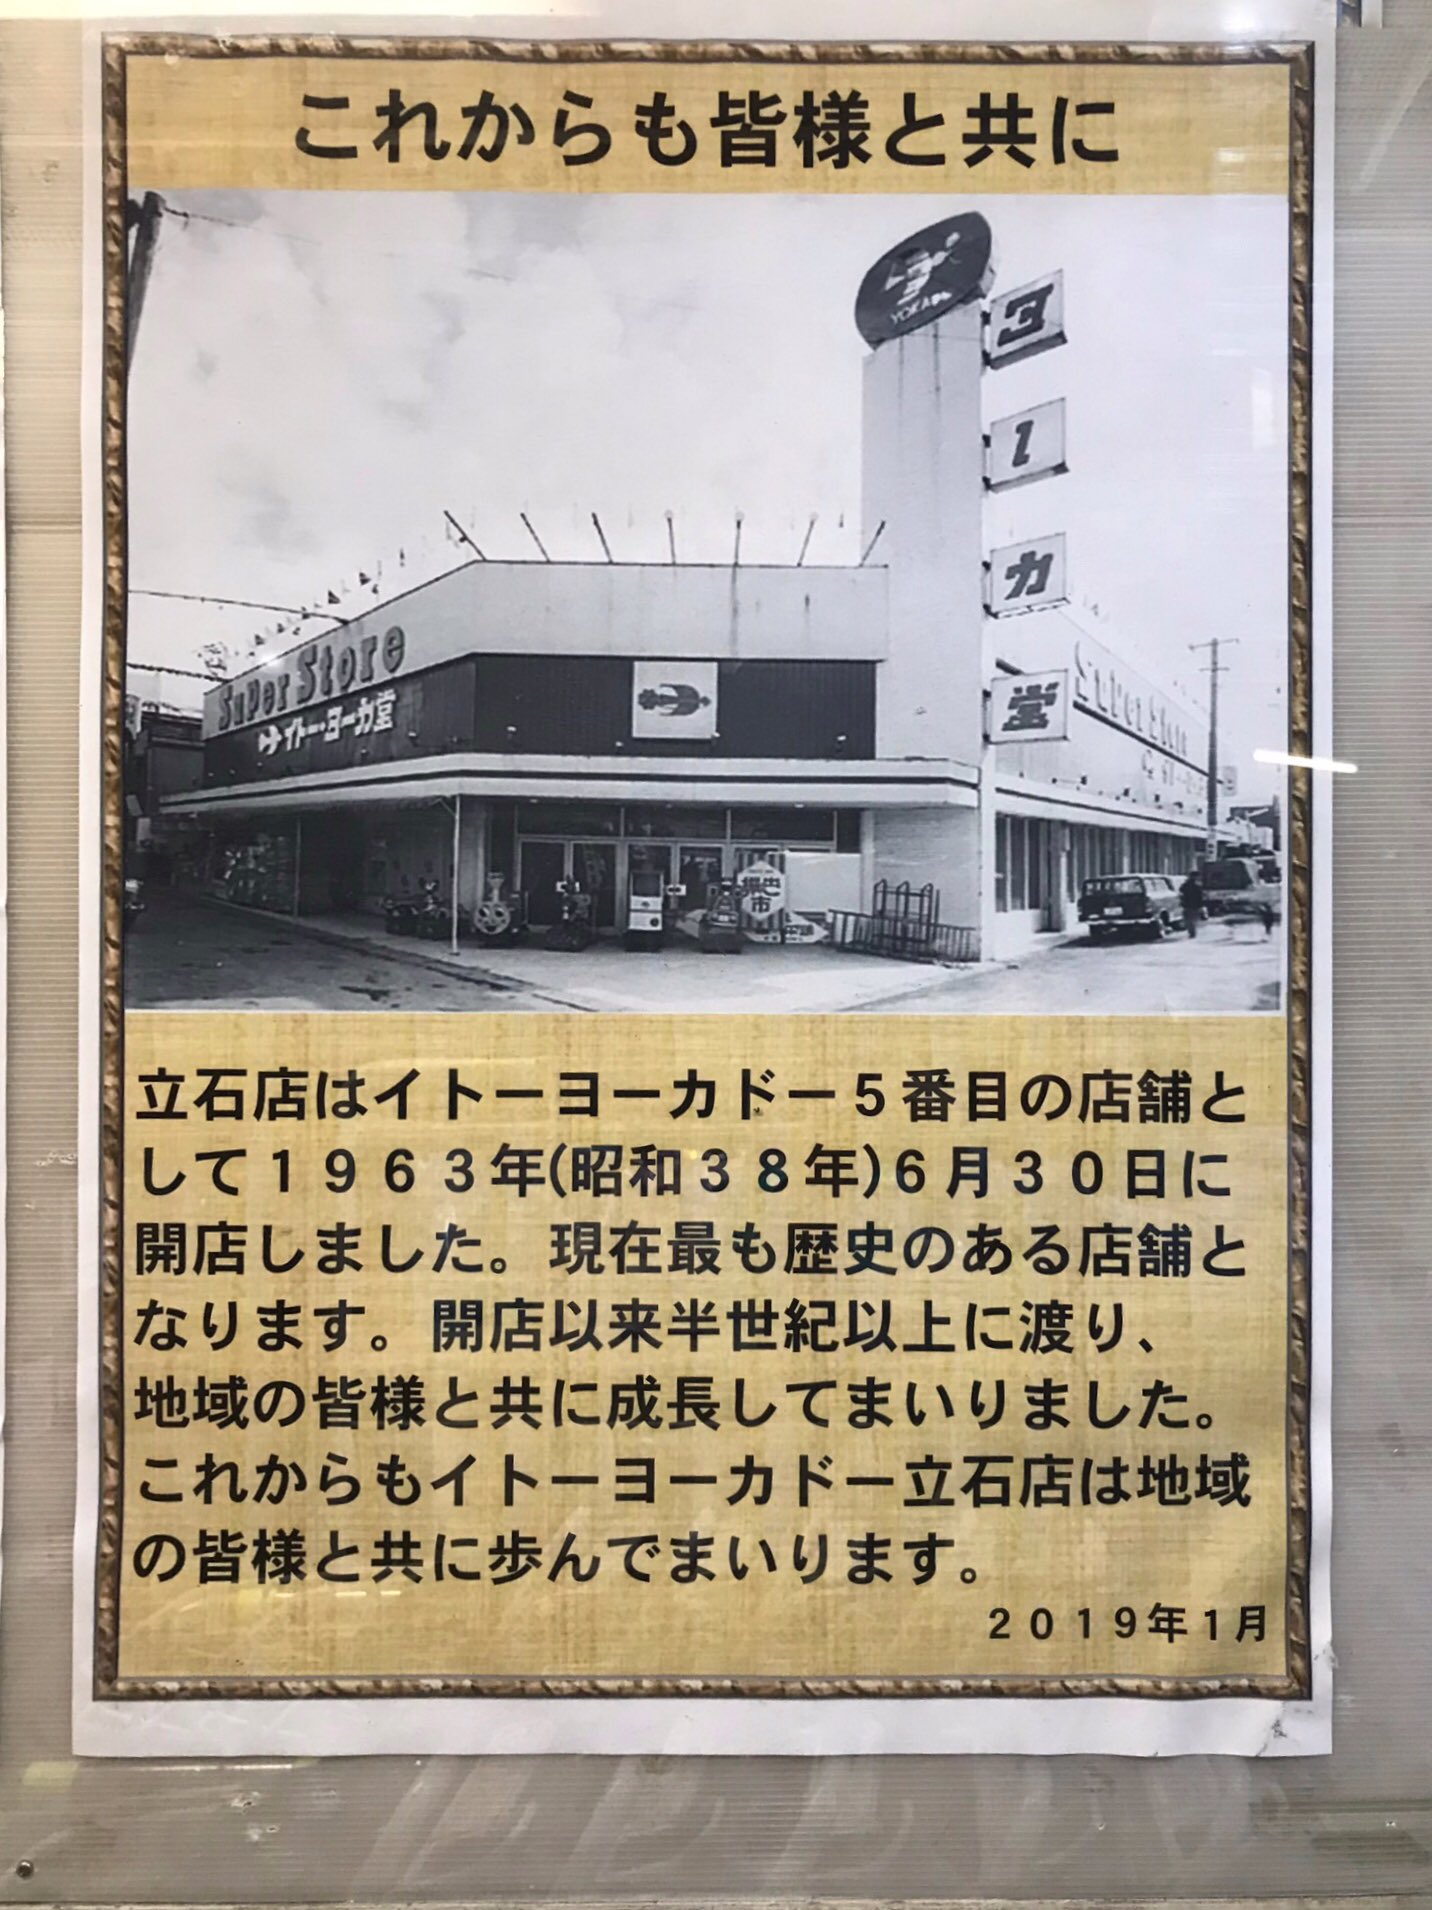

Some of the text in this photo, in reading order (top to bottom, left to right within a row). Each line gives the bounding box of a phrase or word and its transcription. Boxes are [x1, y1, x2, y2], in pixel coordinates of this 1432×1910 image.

[294, 88, 1119, 168] これからも皆様と共に
[297, 625, 406, 705] Store
[136, 1066, 1246, 1124] 立石店はイトーヨーカドー5番目の店舗と
[136, 1220, 1246, 1277] 開店しました。現在最も歴史のある店舗と
[134, 1297, 1154, 1354] なります。開店以来半世紀以上に渡り、
[134, 1374, 1214, 1431] 地域の皆様と共に成長してまいりました。
[139, 1451, 1252, 1508] これからもイトーヨーカドー立石店は地域
[133, 1527, 977, 1586] の皆様と共に歩んでまいります。
[989, 1602, 1267, 1644] 2019年1月
